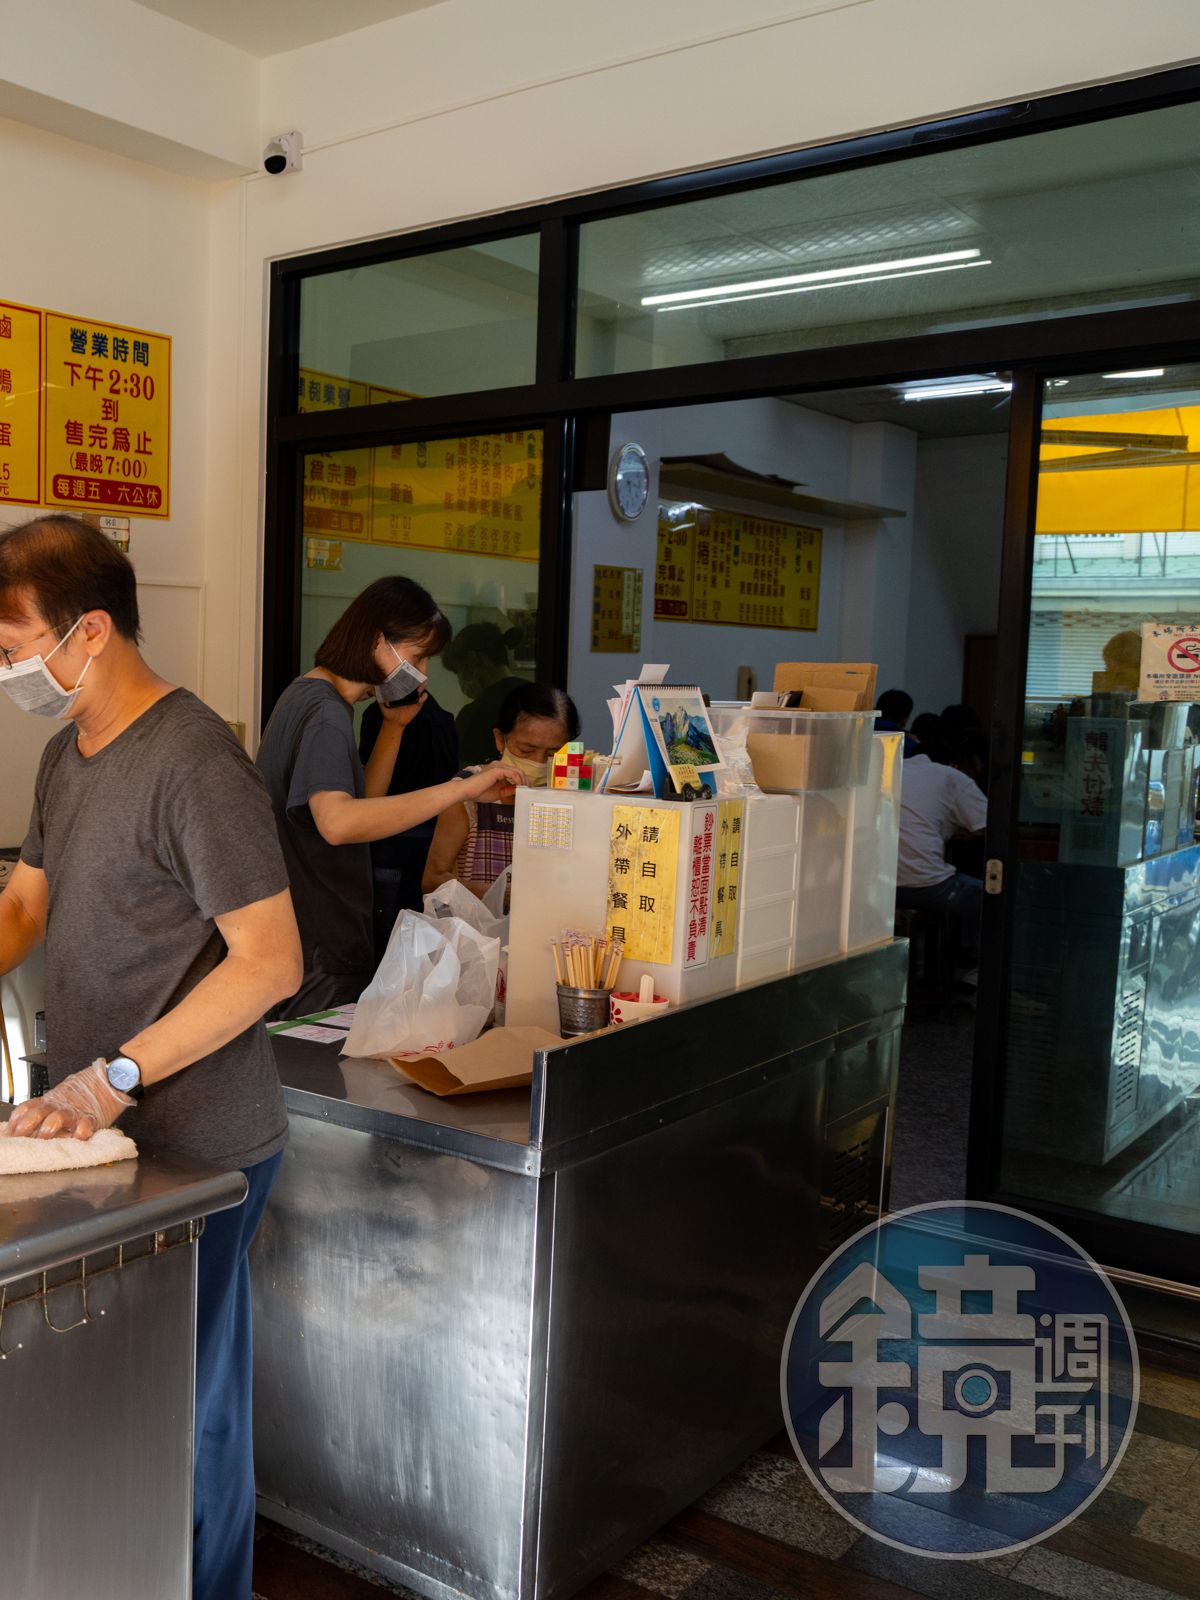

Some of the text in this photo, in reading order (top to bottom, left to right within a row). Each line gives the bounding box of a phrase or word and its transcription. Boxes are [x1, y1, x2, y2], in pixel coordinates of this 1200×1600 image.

[70, 327, 150, 367] 營業時間
[63, 361, 155, 401] 下午2:30
[101, 398, 120, 423] 到
[611, 823, 633, 945] 外帶餐具
[638, 825, 660, 913] 請自取
